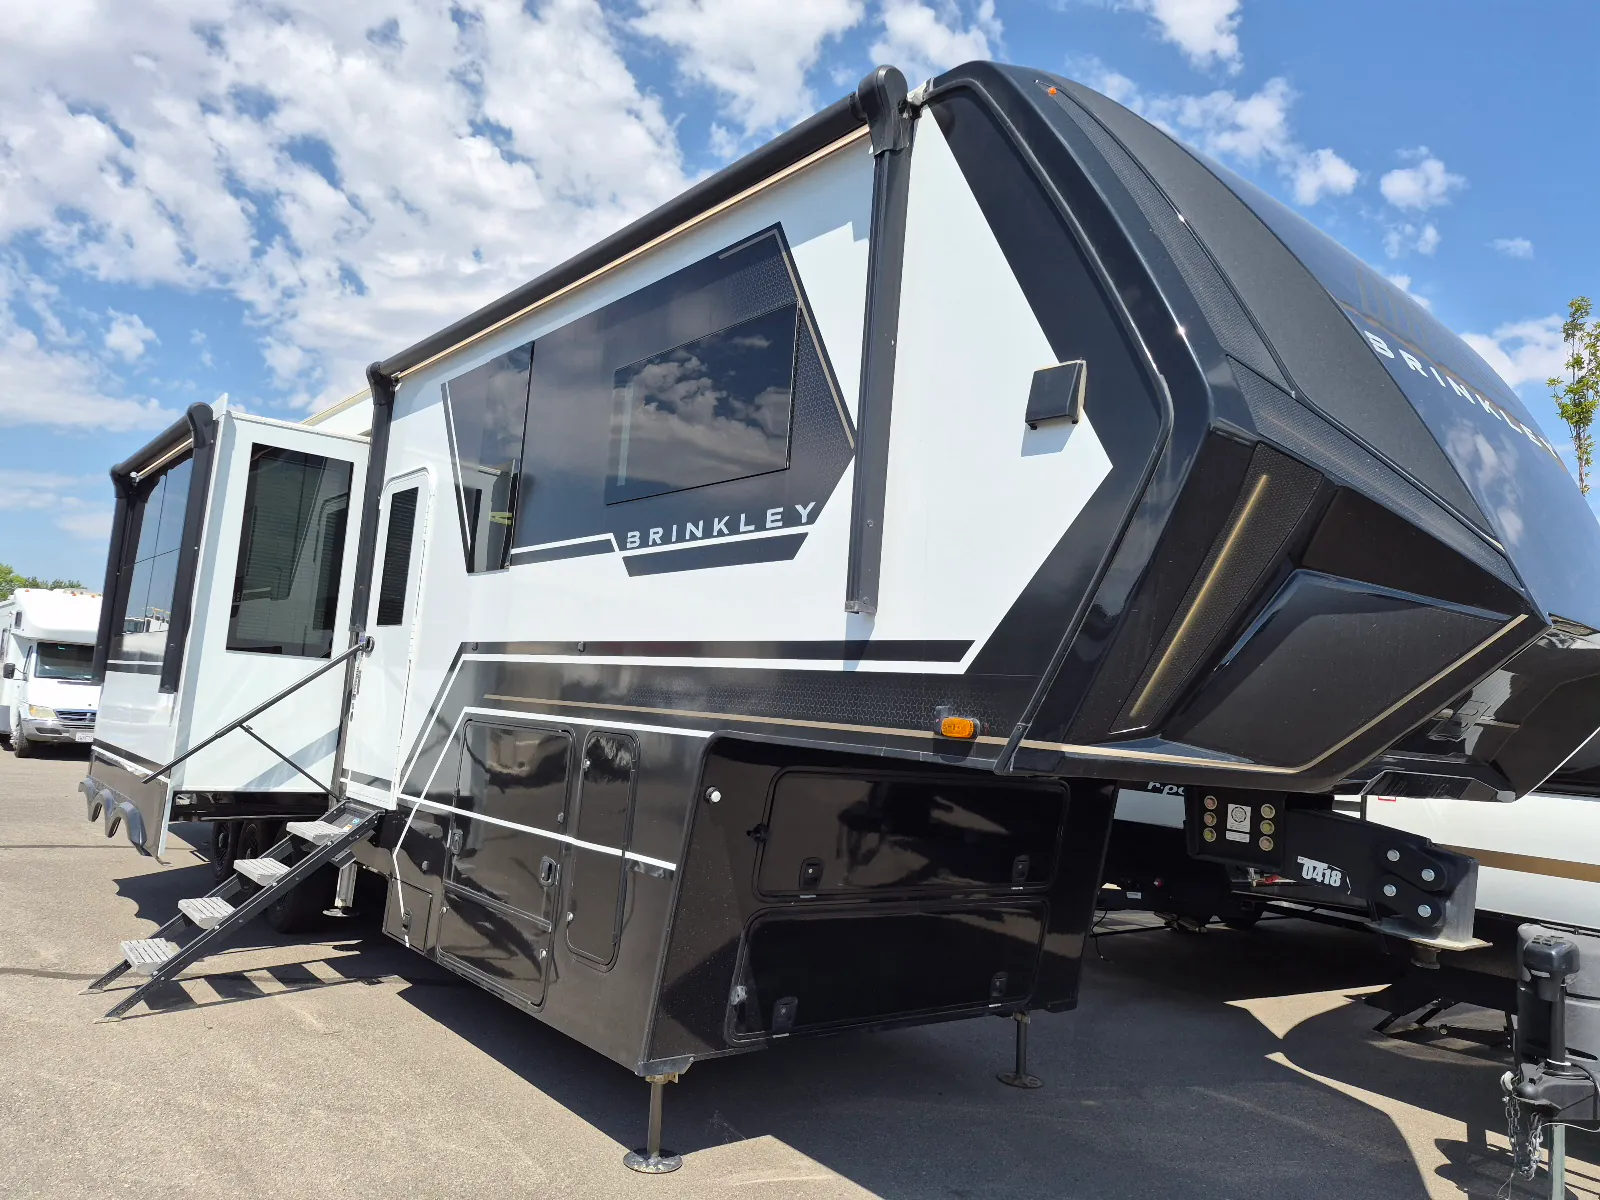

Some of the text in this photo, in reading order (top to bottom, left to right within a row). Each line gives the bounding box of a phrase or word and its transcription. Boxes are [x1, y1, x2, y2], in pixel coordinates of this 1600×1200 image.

[1364, 330, 1558, 459] BRINKLEY
[626, 501, 816, 549] BRINKLEY
[1301, 862, 1342, 887] 0418
